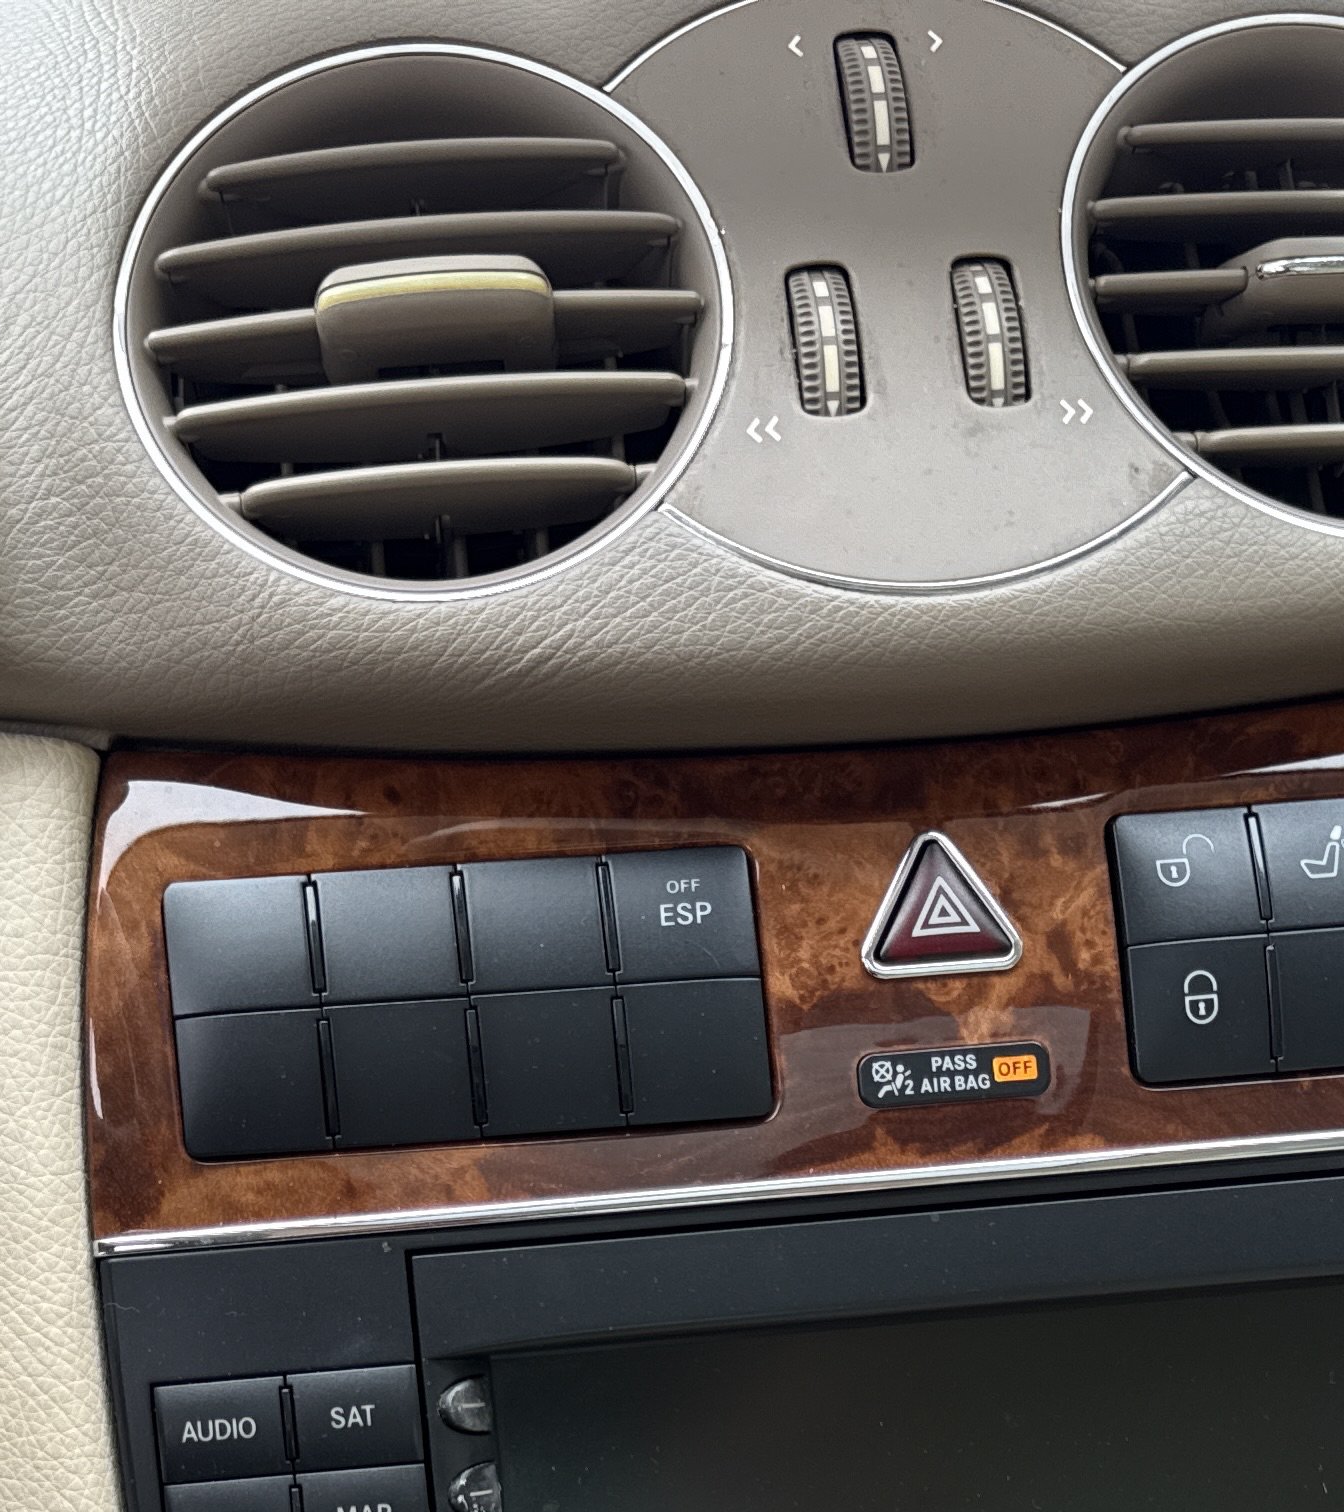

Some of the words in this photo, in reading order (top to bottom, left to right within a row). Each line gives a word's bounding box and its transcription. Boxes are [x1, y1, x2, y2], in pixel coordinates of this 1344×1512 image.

[665, 877, 701, 895] OFF
[658, 901, 713, 927] ESP
[931, 1054, 977, 1072] PASS
[998, 1060, 1034, 1077] OFF
[329, 1404, 376, 1430] SAT
[182, 1416, 257, 1443] AUDIO
